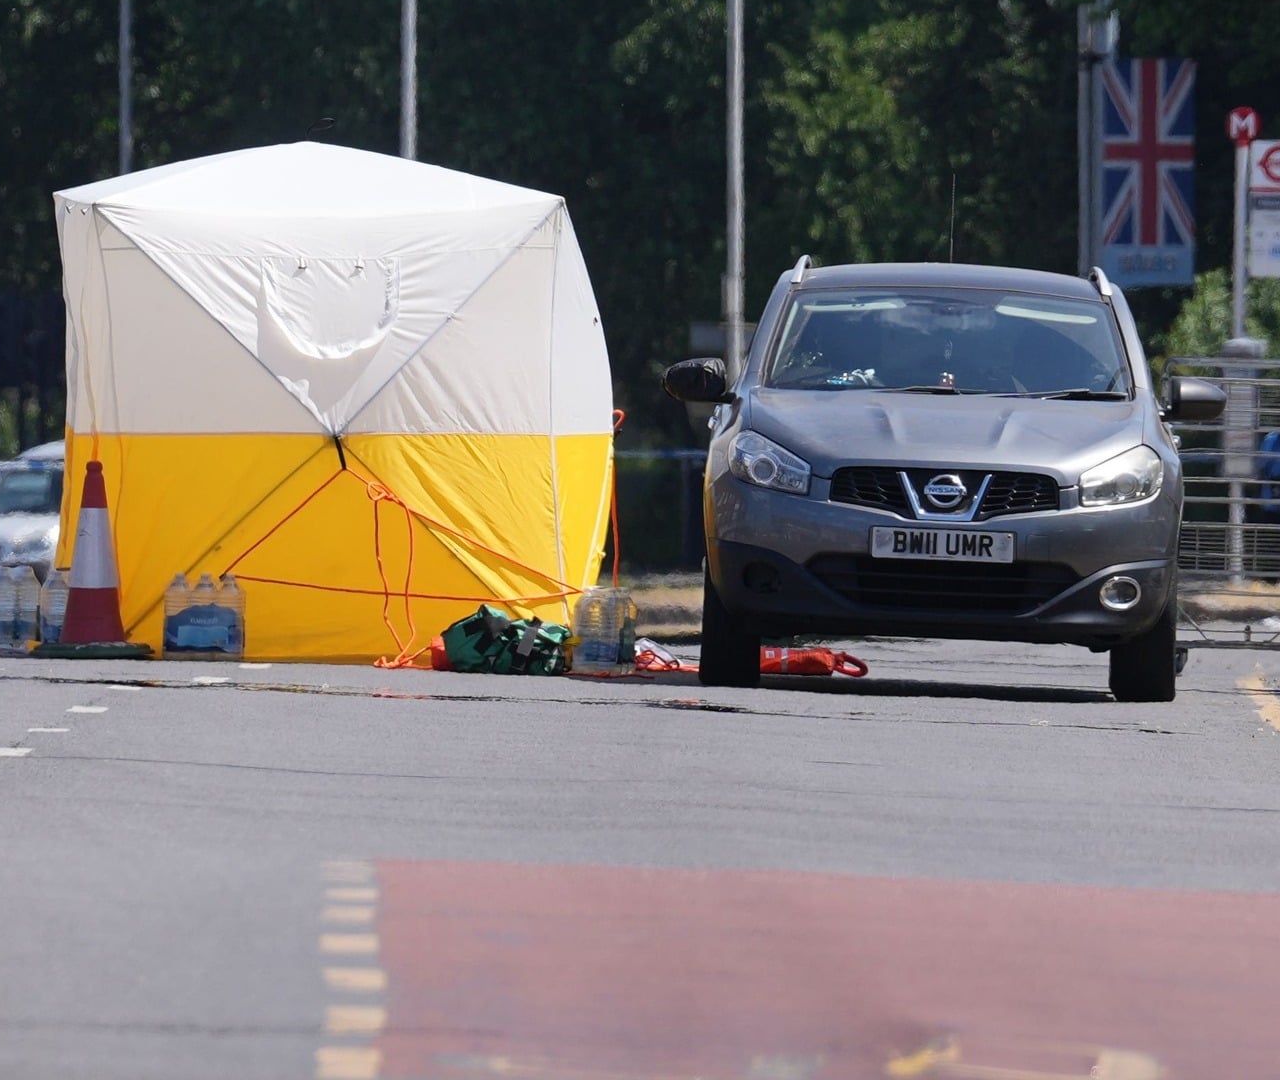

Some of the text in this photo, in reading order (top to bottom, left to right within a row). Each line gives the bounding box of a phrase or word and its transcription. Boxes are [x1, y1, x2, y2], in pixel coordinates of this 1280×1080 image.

[1230, 111, 1256, 138] M
[893, 531, 993, 557] BW11 UMR
